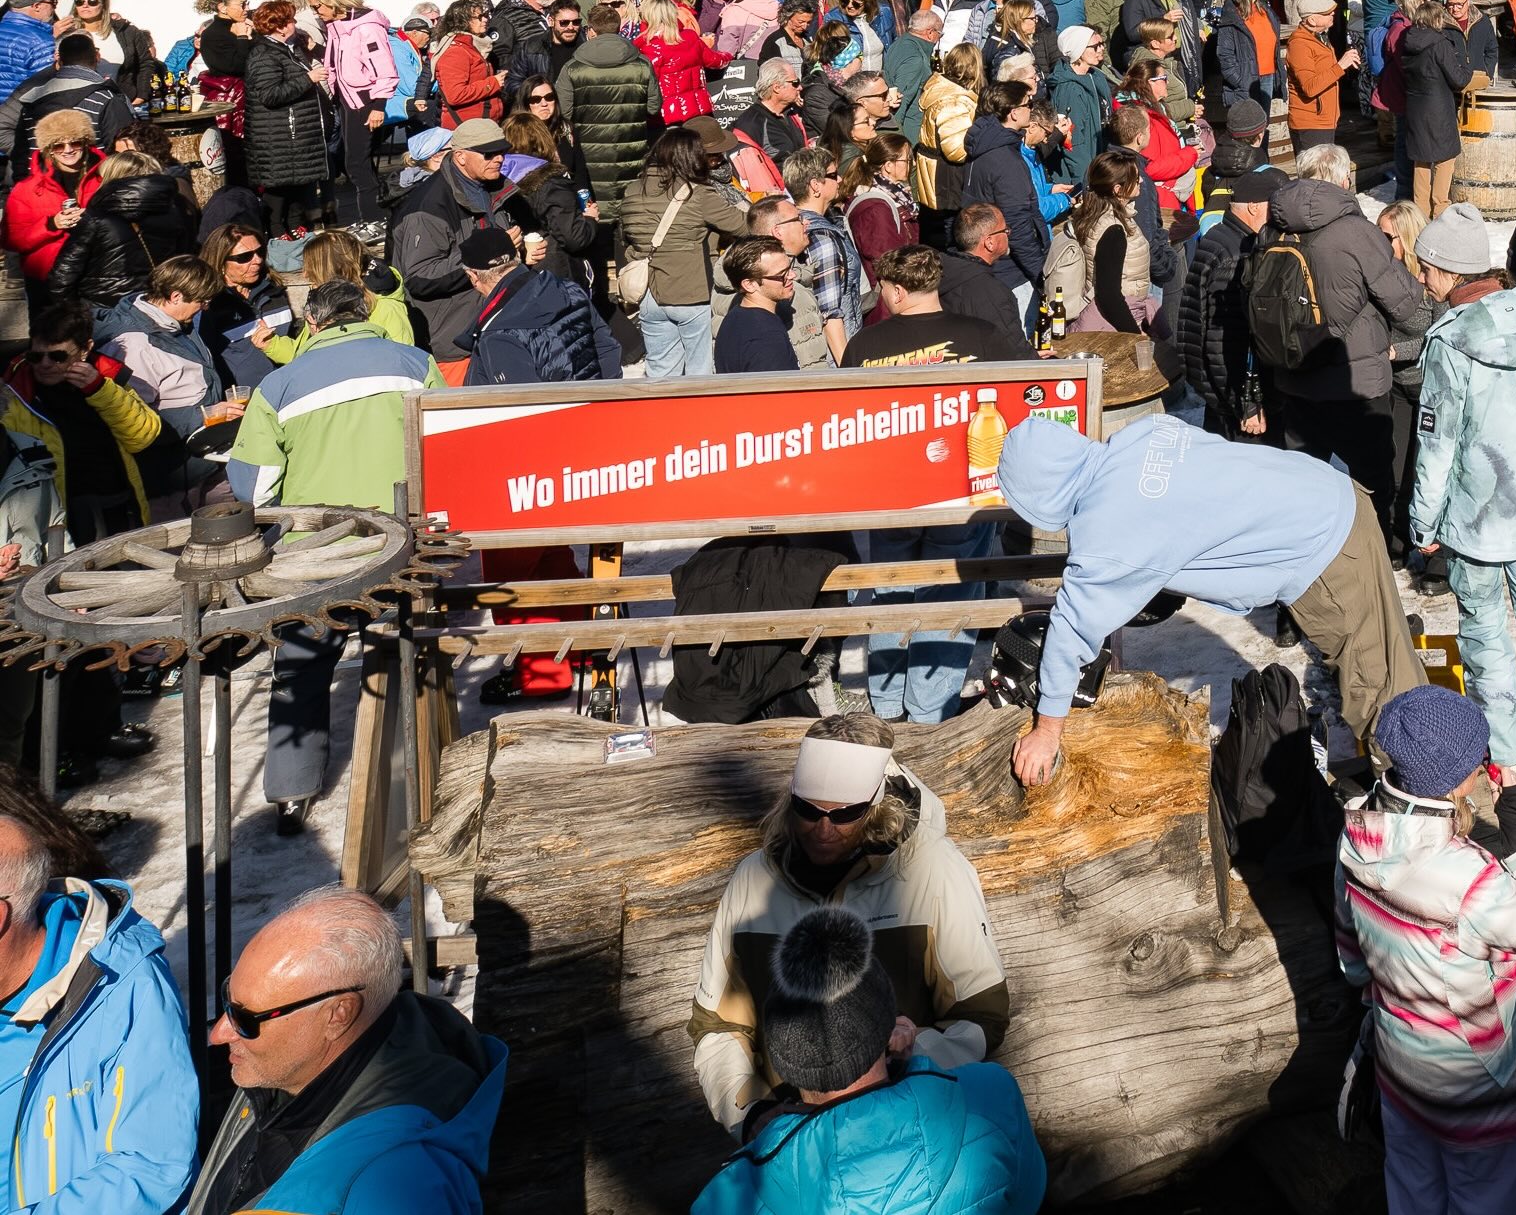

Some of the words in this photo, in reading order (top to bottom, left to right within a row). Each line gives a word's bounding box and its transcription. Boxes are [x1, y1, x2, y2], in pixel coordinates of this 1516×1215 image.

[507, 473, 555, 513] Wo
[563, 456, 657, 503] immer
[665, 439, 727, 482] dein
[735, 421, 814, 469] Durst
[821, 401, 925, 451] daheim
[1138, 450, 1173, 498] OFF
